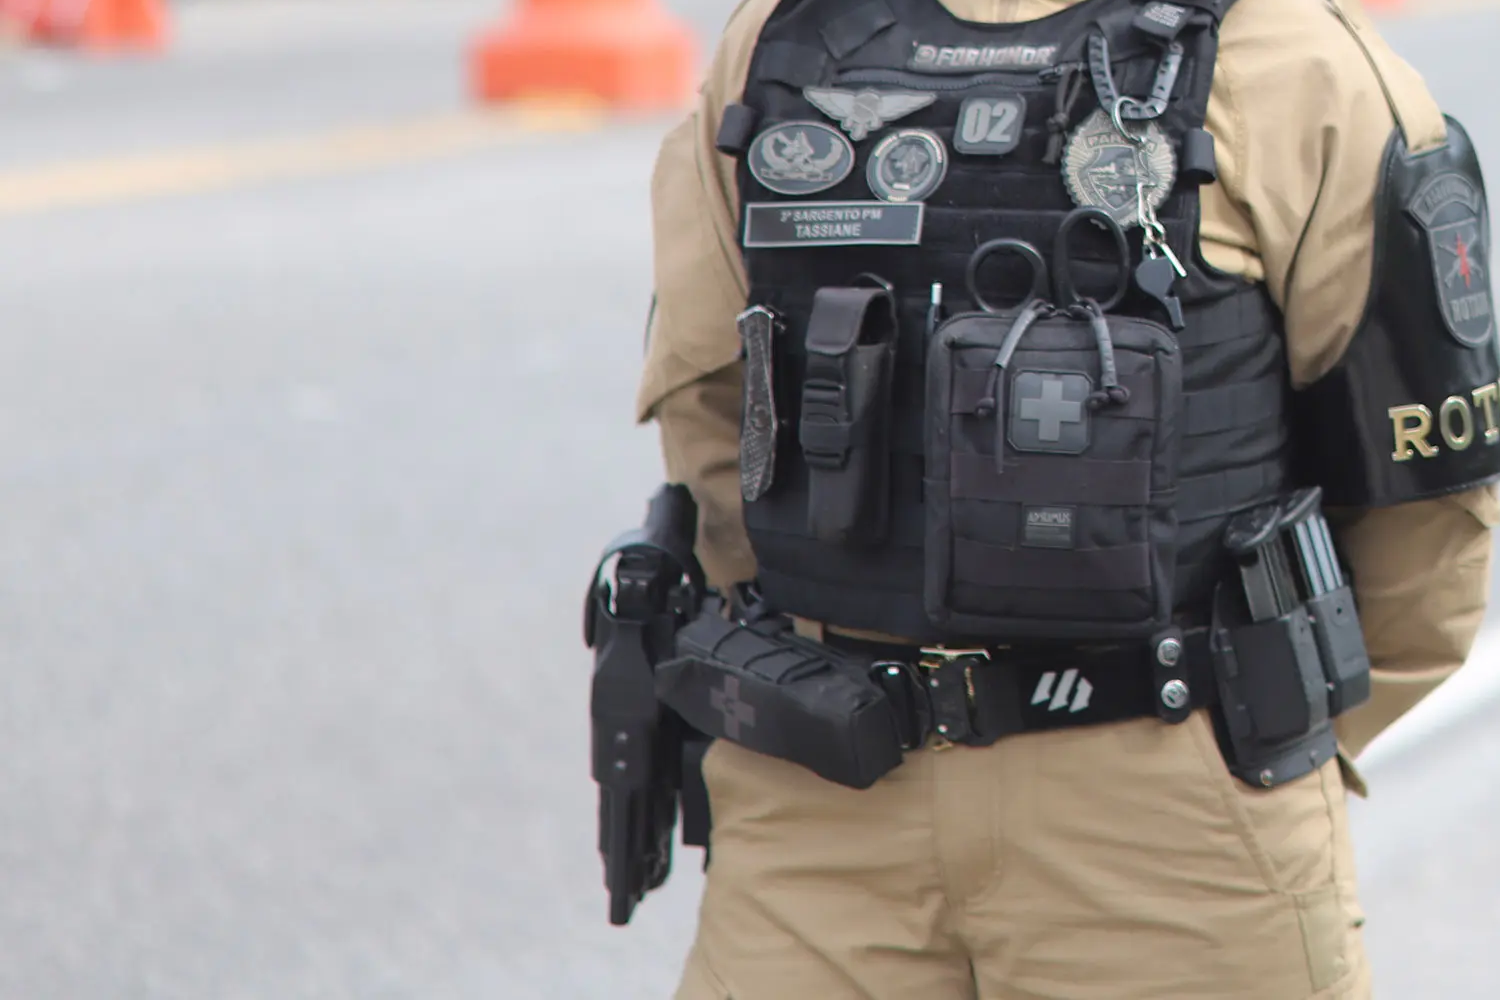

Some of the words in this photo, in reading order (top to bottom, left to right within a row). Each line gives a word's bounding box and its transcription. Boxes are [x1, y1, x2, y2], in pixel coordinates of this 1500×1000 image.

[961, 100, 1018, 144] 02
[793, 208, 860, 222] SARGENTO
[861, 207, 884, 221] PM
[795, 223, 862, 239] TASSIANE
